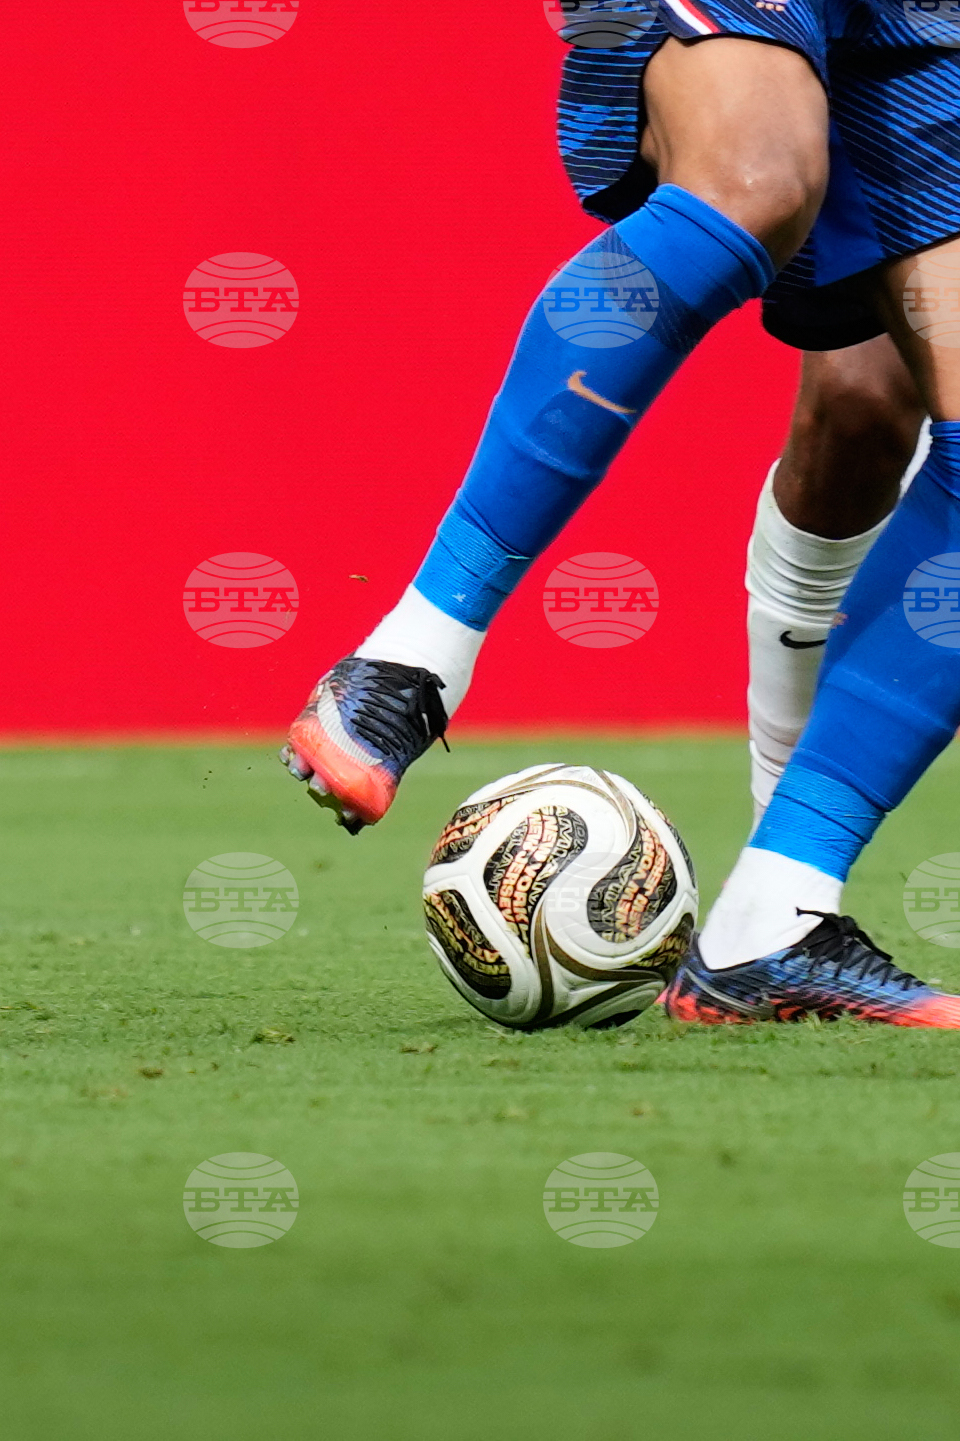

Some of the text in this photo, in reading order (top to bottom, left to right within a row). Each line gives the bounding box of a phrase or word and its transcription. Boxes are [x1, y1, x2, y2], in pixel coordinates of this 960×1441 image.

[498, 814, 540, 921] NEW JERSEY
[512, 815, 558, 923] NEW YORK
[613, 828, 654, 931] NEW YORK
